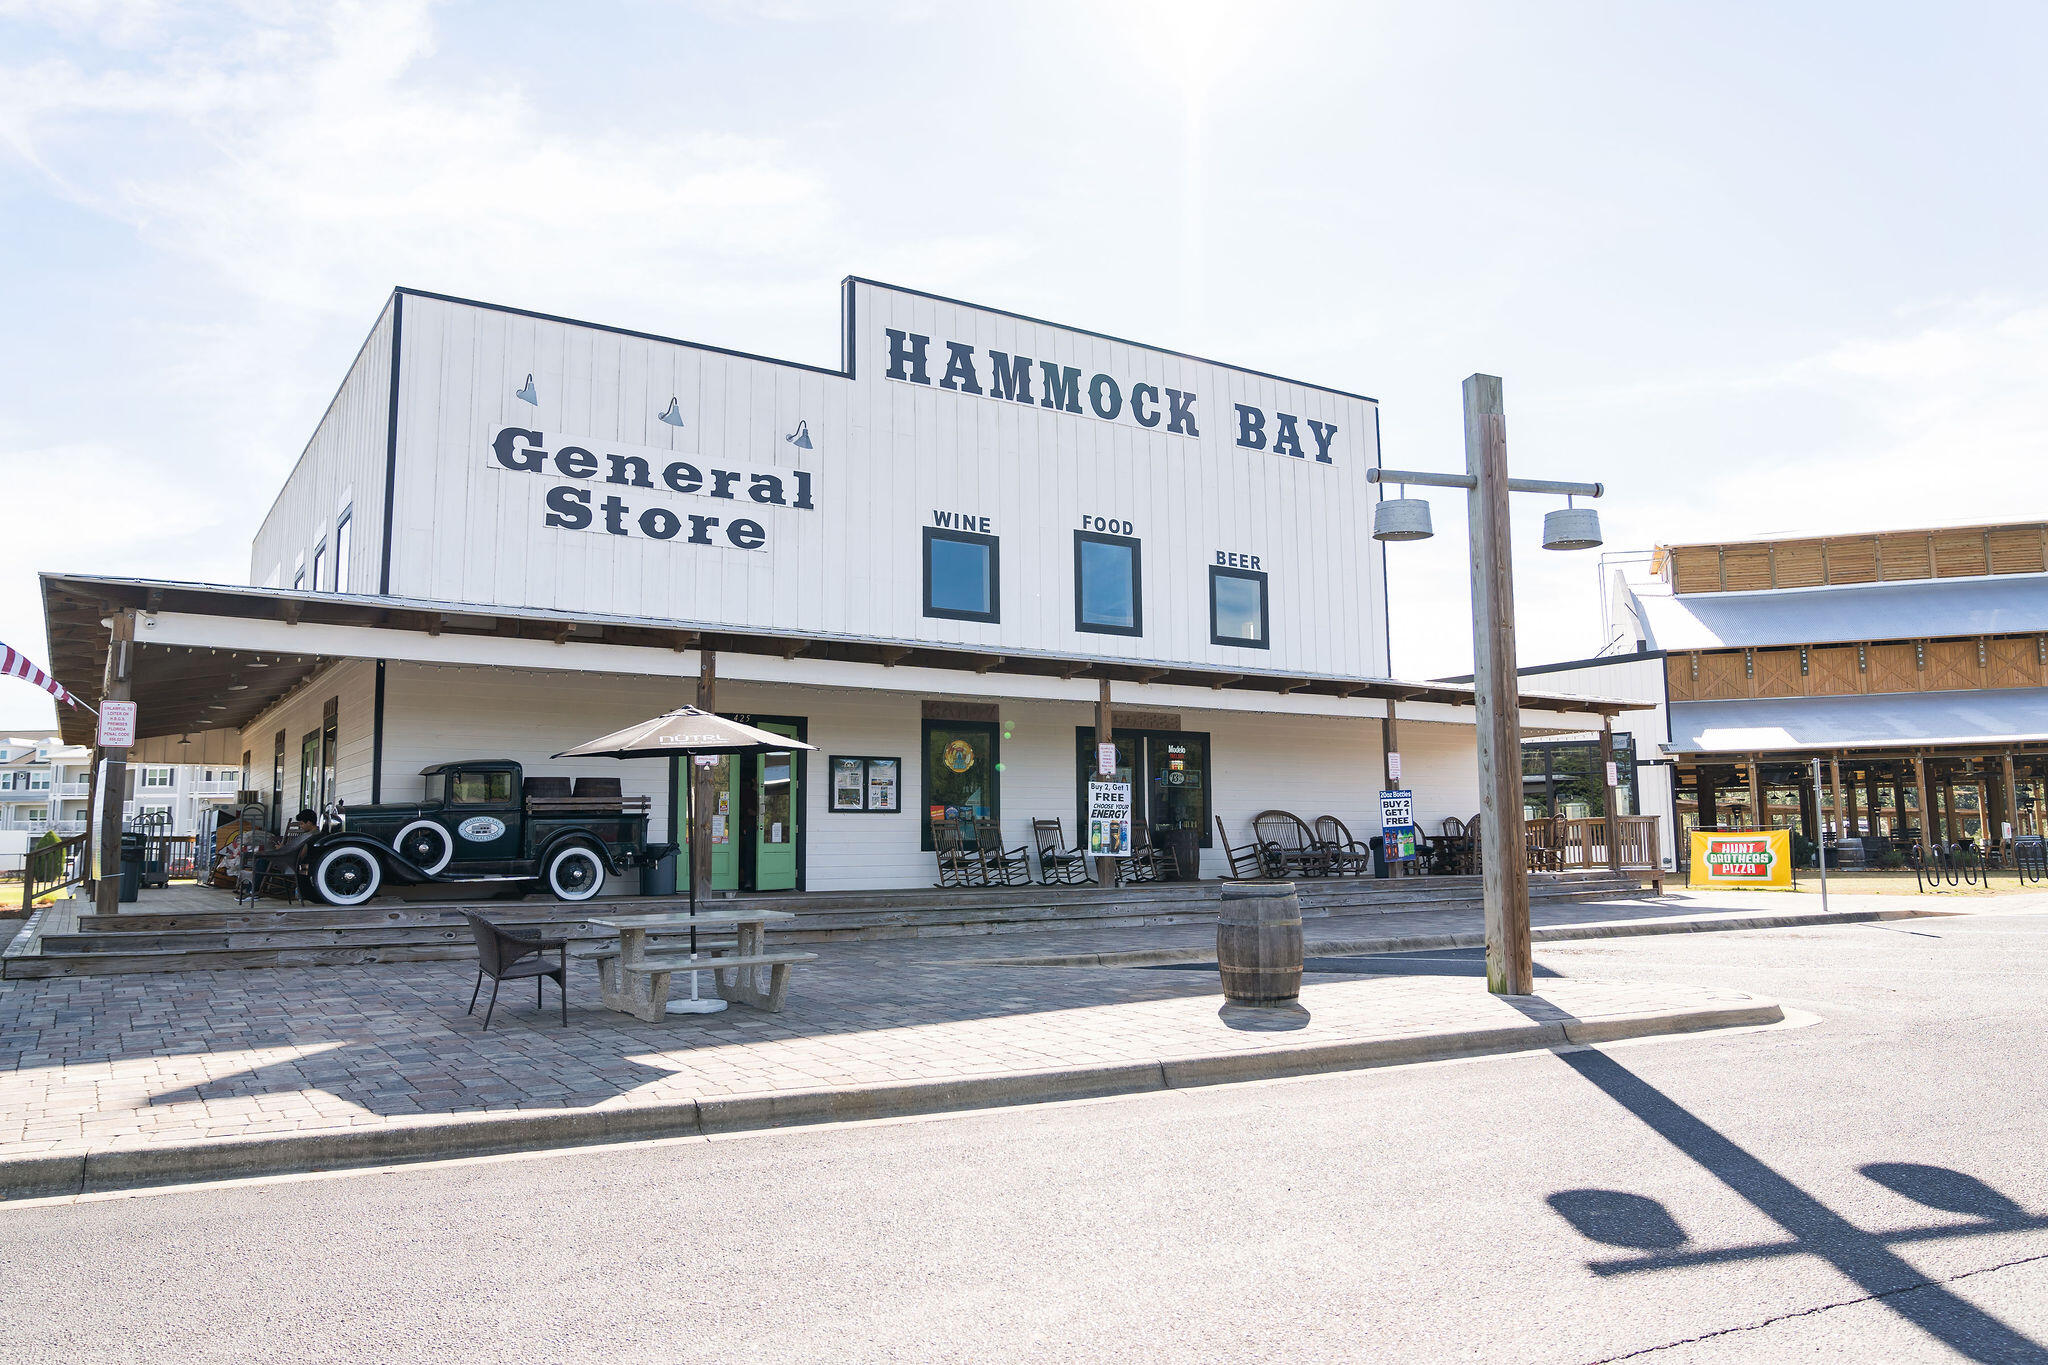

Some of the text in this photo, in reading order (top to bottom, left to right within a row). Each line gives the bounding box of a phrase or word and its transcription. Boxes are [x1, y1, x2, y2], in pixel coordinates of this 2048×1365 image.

[885, 327, 1338, 465] HAMMOCK BAY
[492, 426, 815, 511] General
[545, 485, 766, 550] Store
[932, 510, 991, 534] WINE
[1082, 514, 1134, 536] FOOD
[1215, 550, 1262, 571] BEER
[733, 714, 751, 723] 425
[1091, 783, 1102, 791] Buy
[1096, 793, 1124, 802] FREE
[1091, 810, 1128, 818] ENERGY
[1721, 843, 1755, 854] HUNT
[1710, 853, 1769, 864] BROTHERS
[1722, 863, 1756, 874] PIZZA
